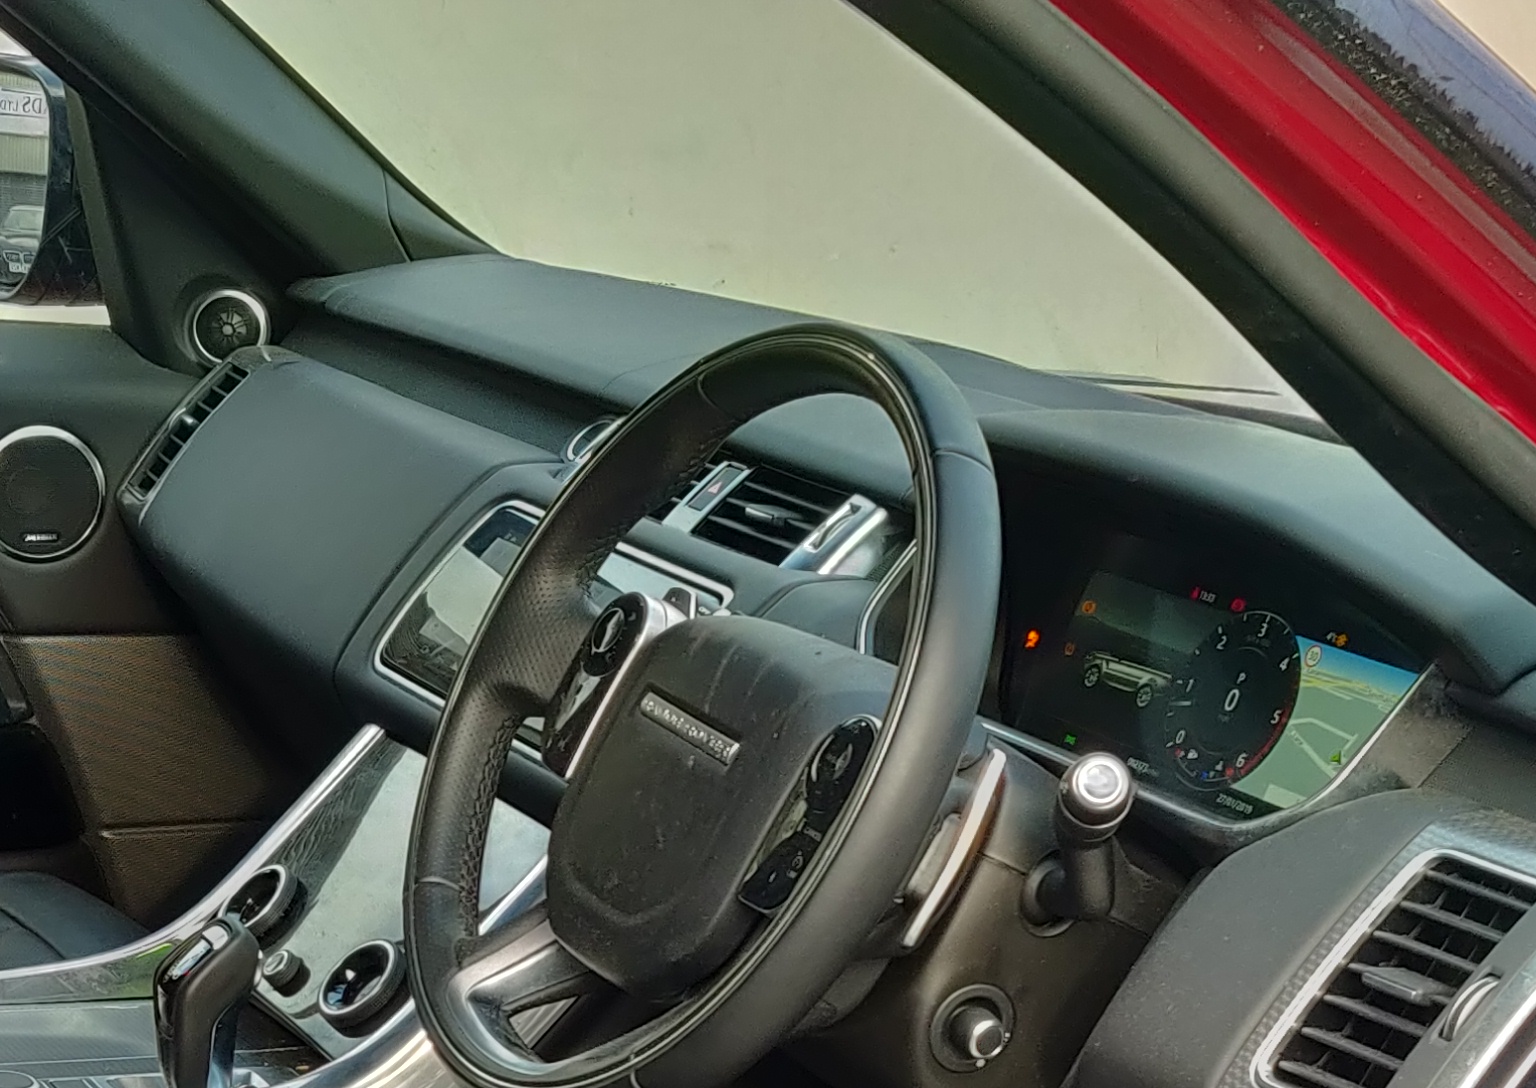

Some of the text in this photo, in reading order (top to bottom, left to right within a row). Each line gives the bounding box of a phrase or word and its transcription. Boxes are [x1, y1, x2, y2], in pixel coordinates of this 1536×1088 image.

[1257, 622, 1268, 637] 3
[1216, 635, 1227, 650] 2
[1279, 657, 1290, 671] 4
[1185, 678, 1195, 693] 1
[1237, 672, 1246, 684] P
[1223, 688, 1240, 712] 0
[1270, 709, 1282, 725] 5
[1175, 729, 1186, 744] 0
[1236, 753, 1248, 768] 6
